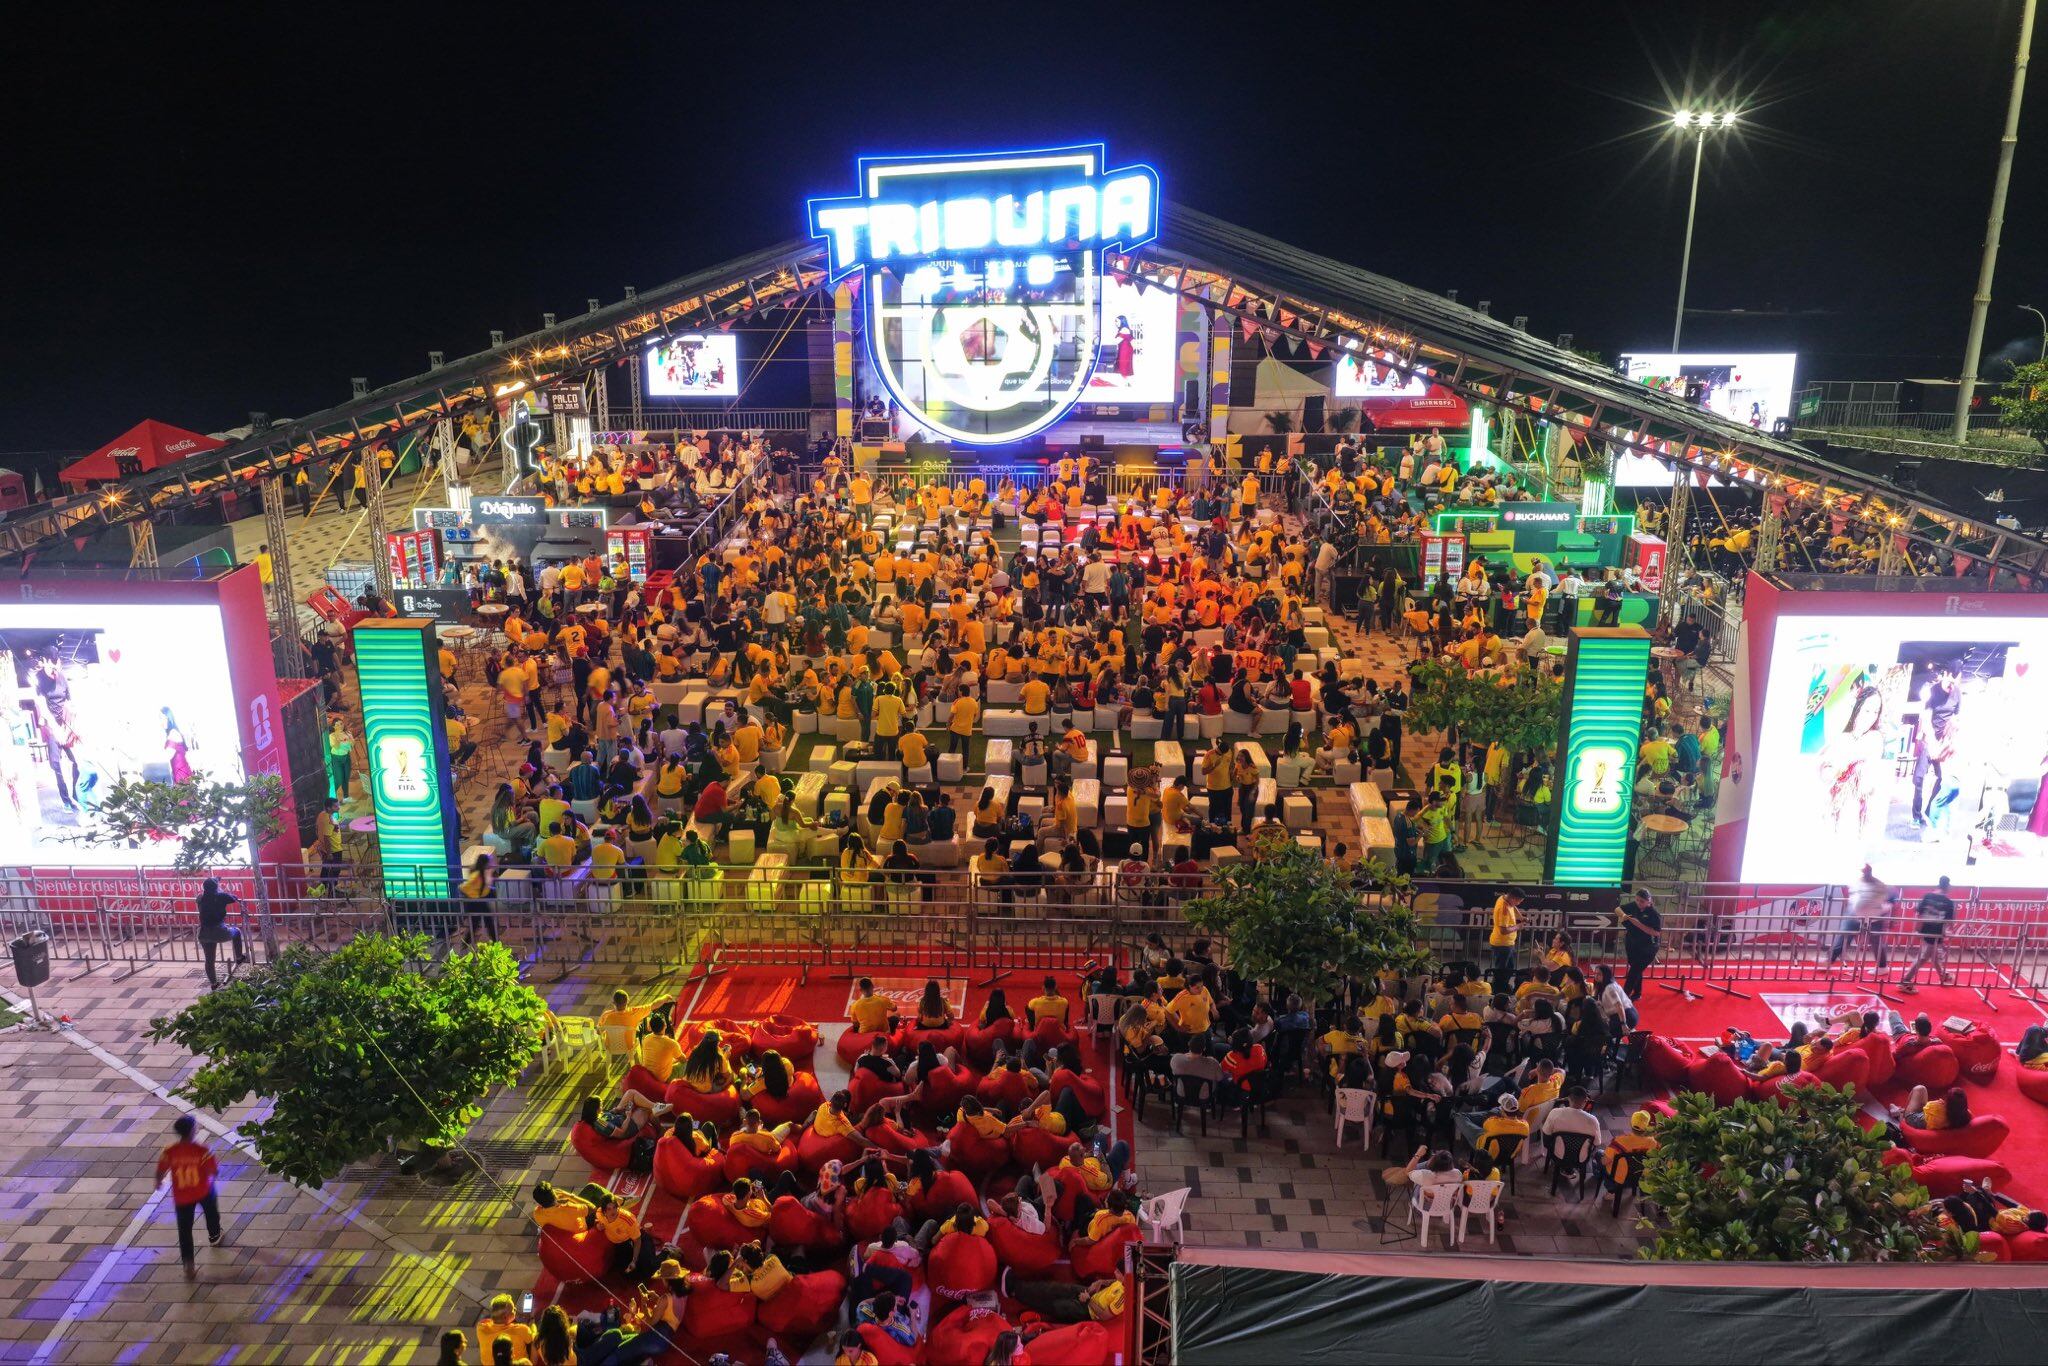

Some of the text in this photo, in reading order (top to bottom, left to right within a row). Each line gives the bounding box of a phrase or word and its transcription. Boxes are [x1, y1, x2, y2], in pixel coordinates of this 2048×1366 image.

[818, 175, 1150, 268] TRIBUNA
[552, 394, 578, 403] PALCO
[165, 440, 198, 453] Coca-Cola
[1515, 512, 1570, 522] BUCHANAN'S
[864, 535, 874, 546] 10
[571, 631, 580, 642] 2
[1245, 656, 1256, 667] 10
[1074, 734, 1086, 748] 10
